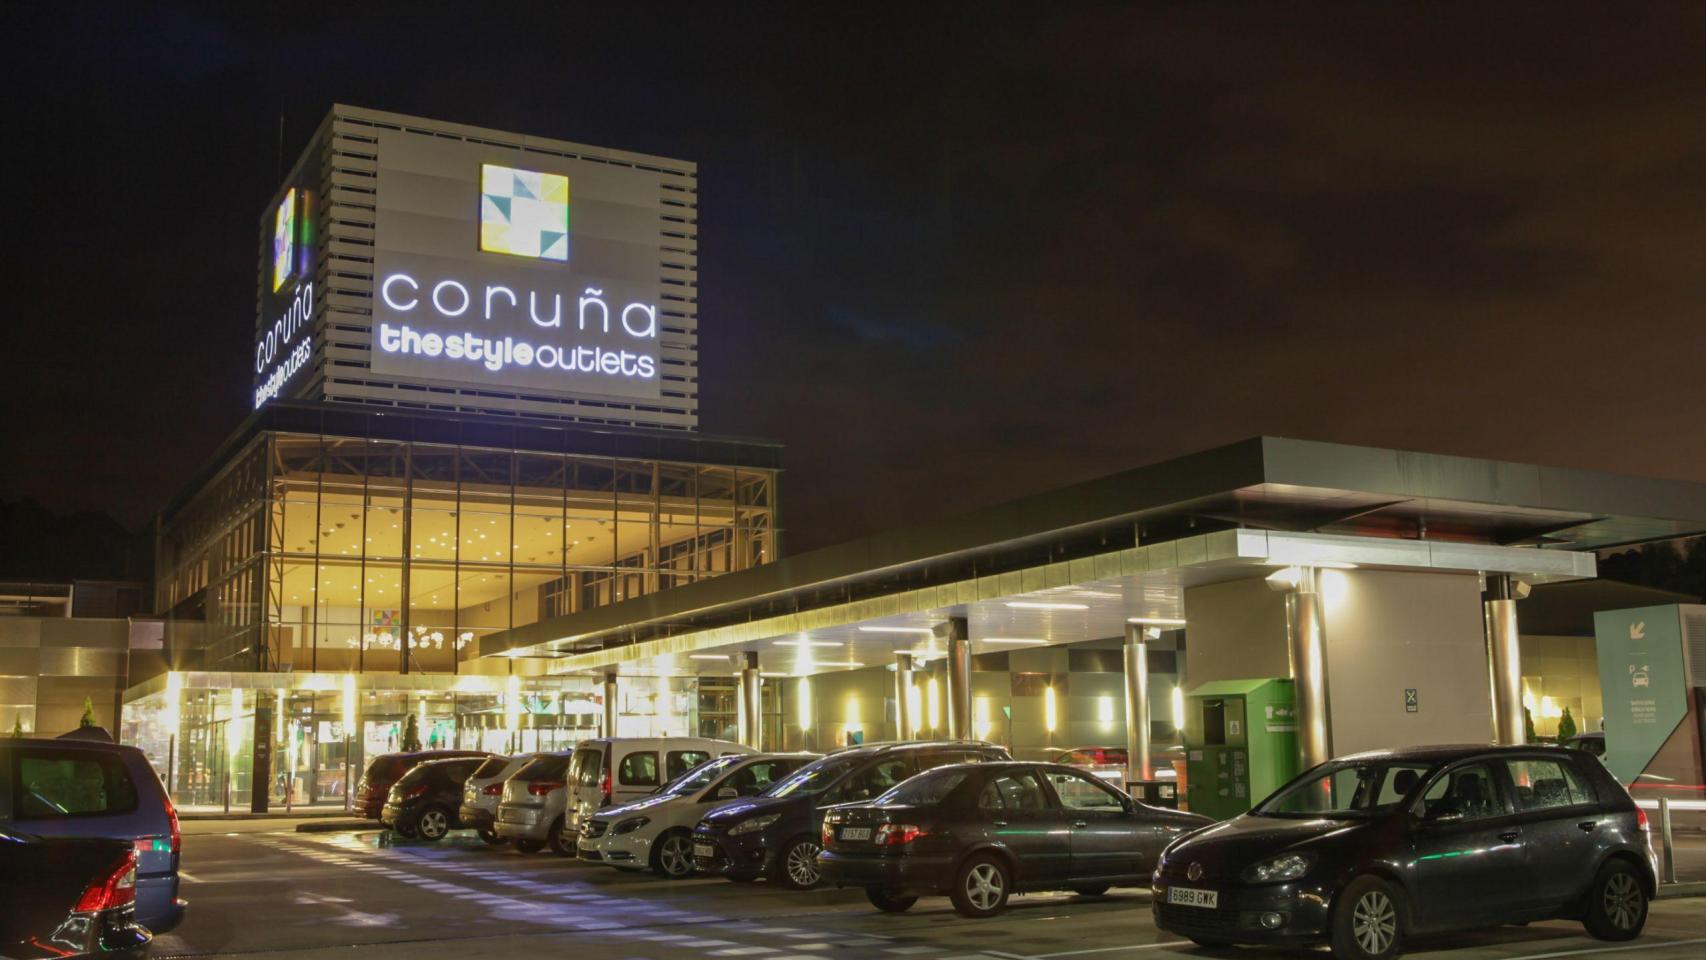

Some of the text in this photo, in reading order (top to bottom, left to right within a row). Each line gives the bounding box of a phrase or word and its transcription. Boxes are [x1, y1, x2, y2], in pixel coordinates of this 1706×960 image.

[257, 282, 312, 373] coruña
[382, 274, 656, 337] coruña
[1173, 889, 1216, 905] 6989 GWK
